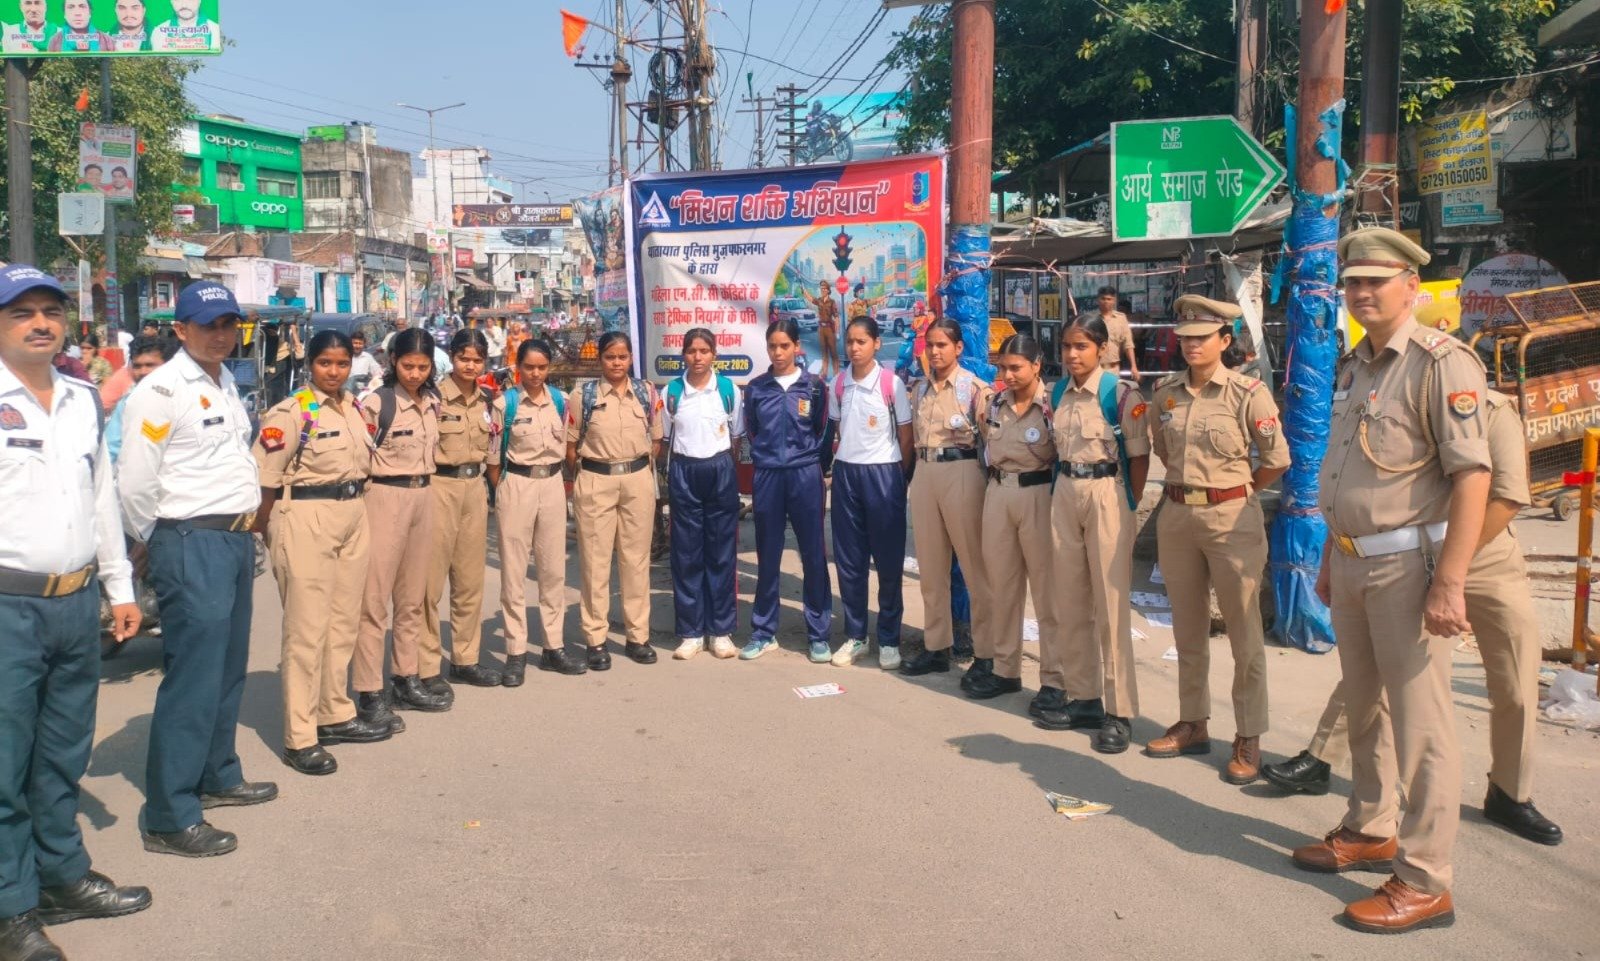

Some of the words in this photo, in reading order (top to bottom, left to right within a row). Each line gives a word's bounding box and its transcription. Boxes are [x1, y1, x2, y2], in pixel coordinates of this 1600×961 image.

[1121, 161, 1152, 203] आर्य
[1161, 171, 1207, 202] समाज
[1216, 157, 1243, 198] रोड
[1429, 166, 1488, 186] 7291050050
[741, 184, 789, 221] शक्ति
[682, 242, 710, 261] पुलिस
[688, 259, 698, 275] के
[202, 292, 229, 302] POLICE
[749, 283, 760, 300] के
[695, 307, 724, 324] नियमों
[727, 306, 737, 323] के
[1545, 381, 1580, 408] प्रदेश
[264, 428, 282, 439] NCC
